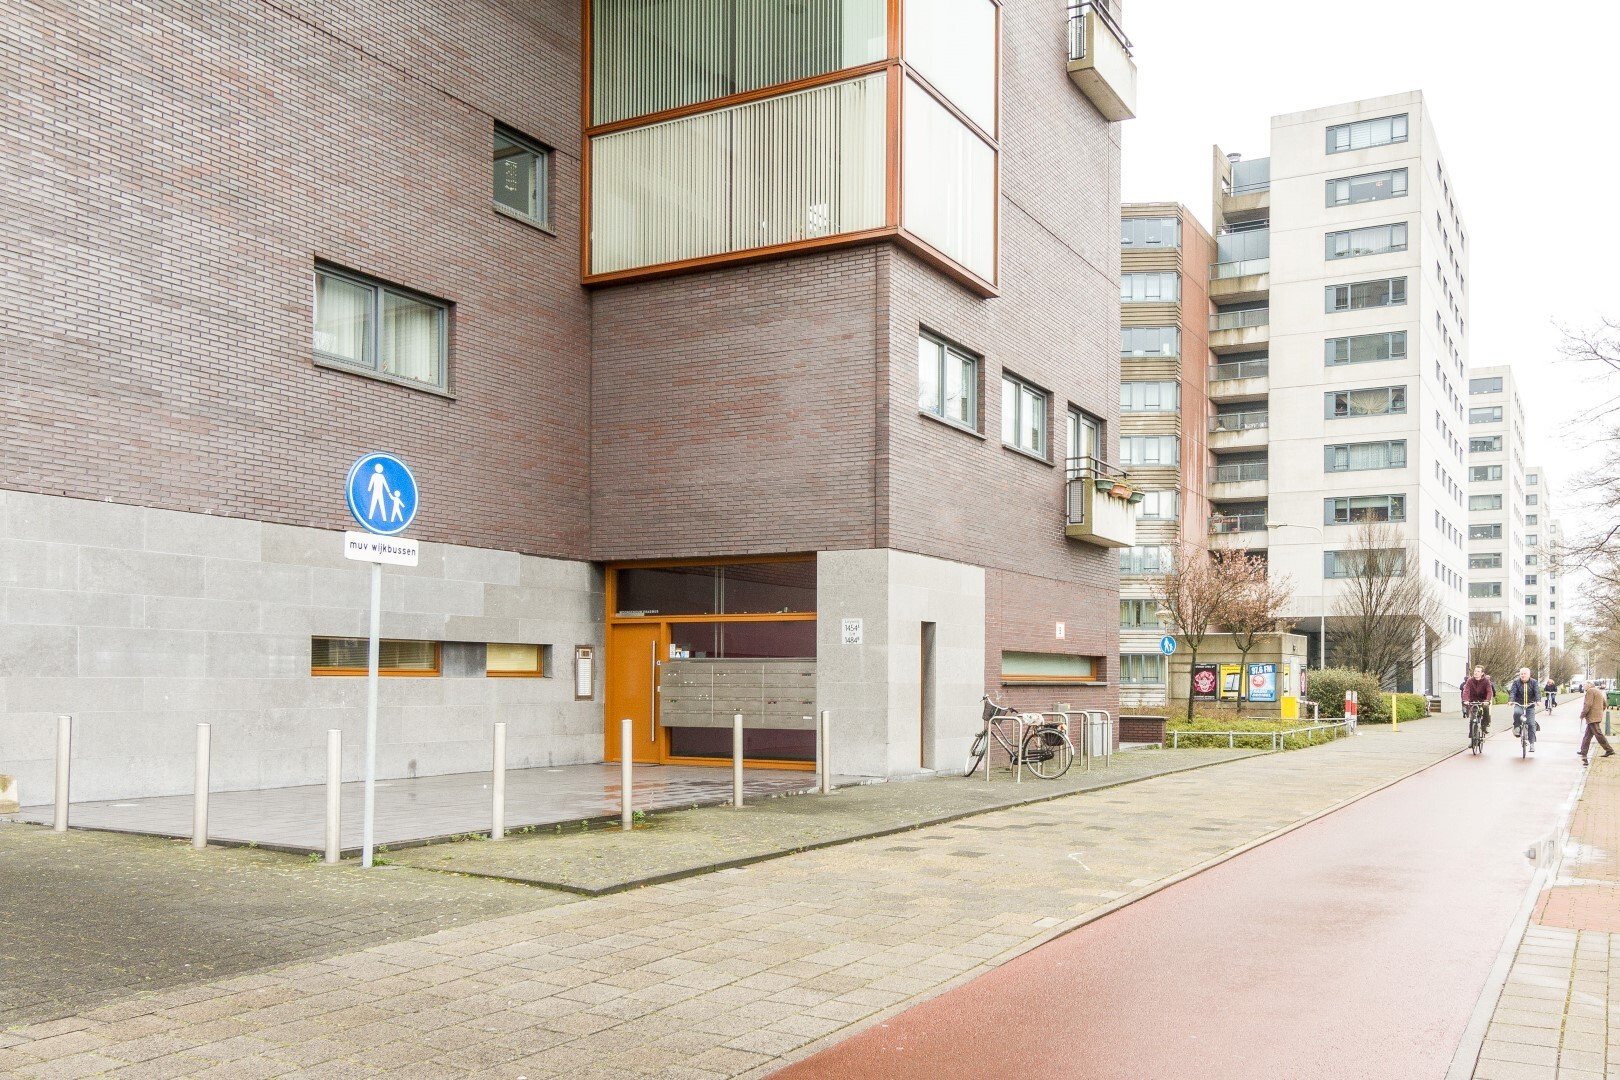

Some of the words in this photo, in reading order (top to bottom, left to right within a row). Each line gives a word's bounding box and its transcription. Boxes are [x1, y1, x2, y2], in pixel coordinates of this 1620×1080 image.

[350, 541, 368, 550] muv
[371, 543, 416, 556] wijkbussen
[1251, 666, 1263, 674] 97.6
[1264, 664, 1273, 673] FM
